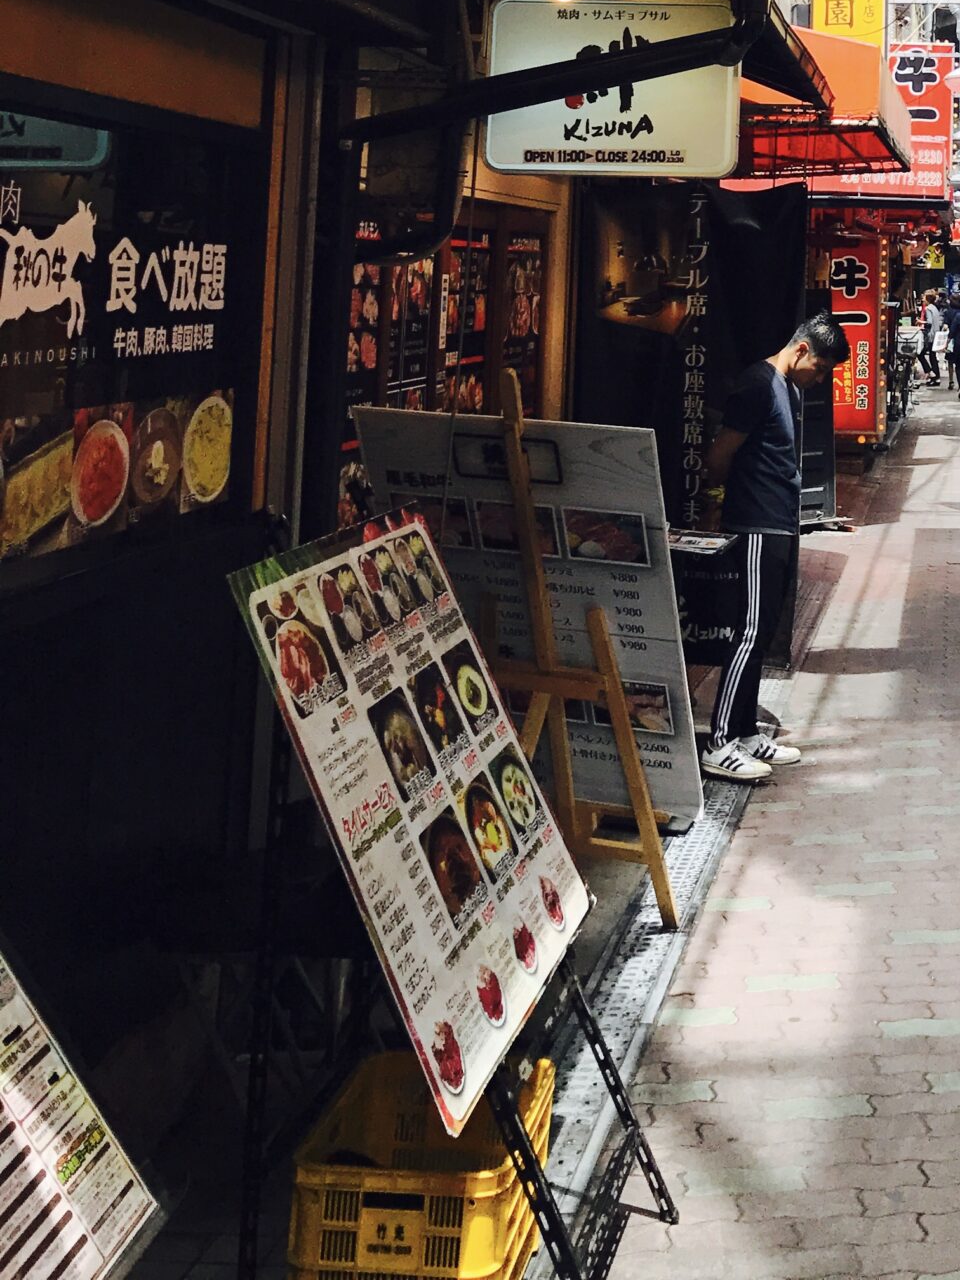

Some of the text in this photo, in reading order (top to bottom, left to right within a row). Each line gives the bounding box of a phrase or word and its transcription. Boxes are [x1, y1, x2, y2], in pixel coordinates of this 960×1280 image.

[556, 8, 671, 21] 焼肉・サムギョプサル
[892, 49, 941, 122] 牛一
[524, 150, 666, 163] OPEN 11:00 CLOSE 24:00
[1, 180, 22, 224] 肉
[12, 245, 67, 293] 秋の牛
[105, 236, 228, 314] 食べ放題
[831, 255, 871, 326] 牛一
[1, 347, 97, 368] AKINOUSHI
[113, 324, 215, 358] 牛肉、豚肉、韓国料理
[681, 192, 710, 560] テーブル席・お座敷席ありま。
[856, 384, 869, 410] 本店
[545, 582, 596, 596] 落ちカルビ
[681, 623, 735, 644] KIZUN
[342, 781, 396, 842] タイムサービス
